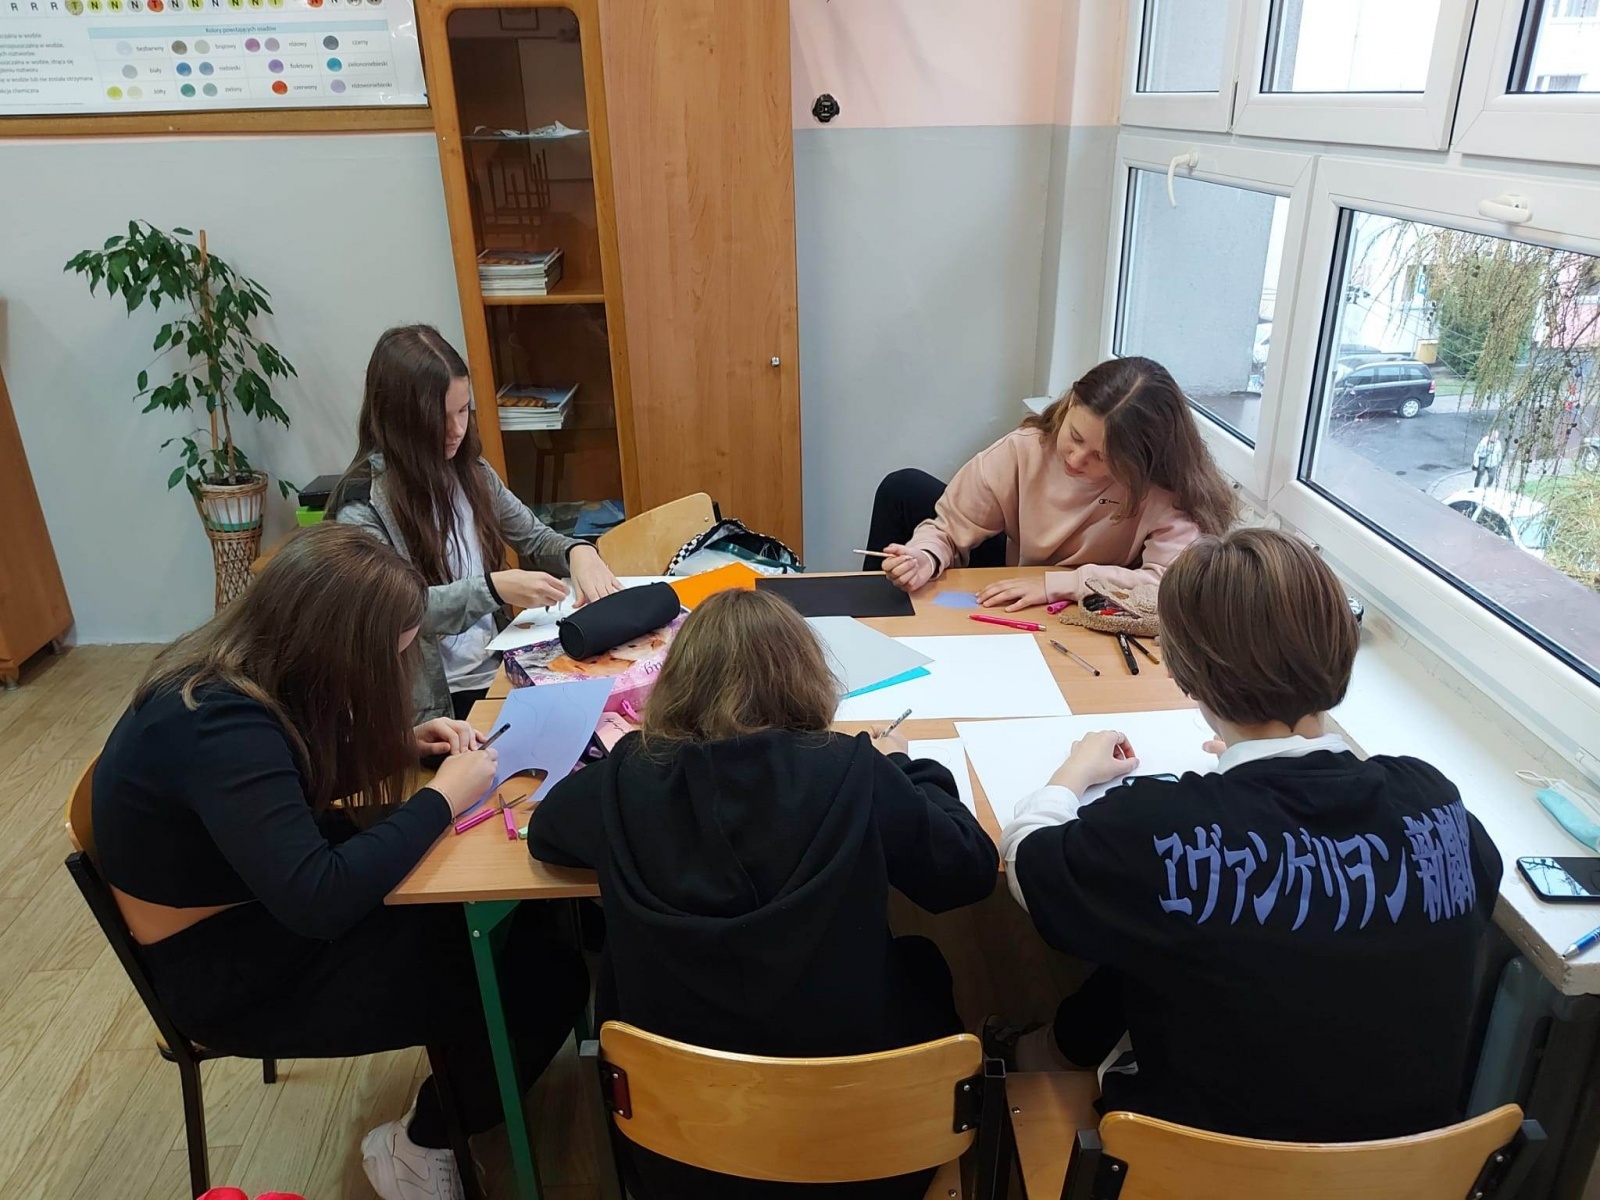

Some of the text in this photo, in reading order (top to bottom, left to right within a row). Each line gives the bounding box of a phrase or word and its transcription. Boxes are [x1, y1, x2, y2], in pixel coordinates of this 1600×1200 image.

[10, 2, 19, 11] R
[30, 2, 39, 11] R
[50, 1, 59, 10] R
[71, 1, 80, 10] T
[91, 1, 99, 10] N
[111, 1, 119, 9] N
[131, 0, 139, 9] N
[151, 0, 159, 8] T
[172, 0, 179, 8] N
[192, 0, 199, 8] N
